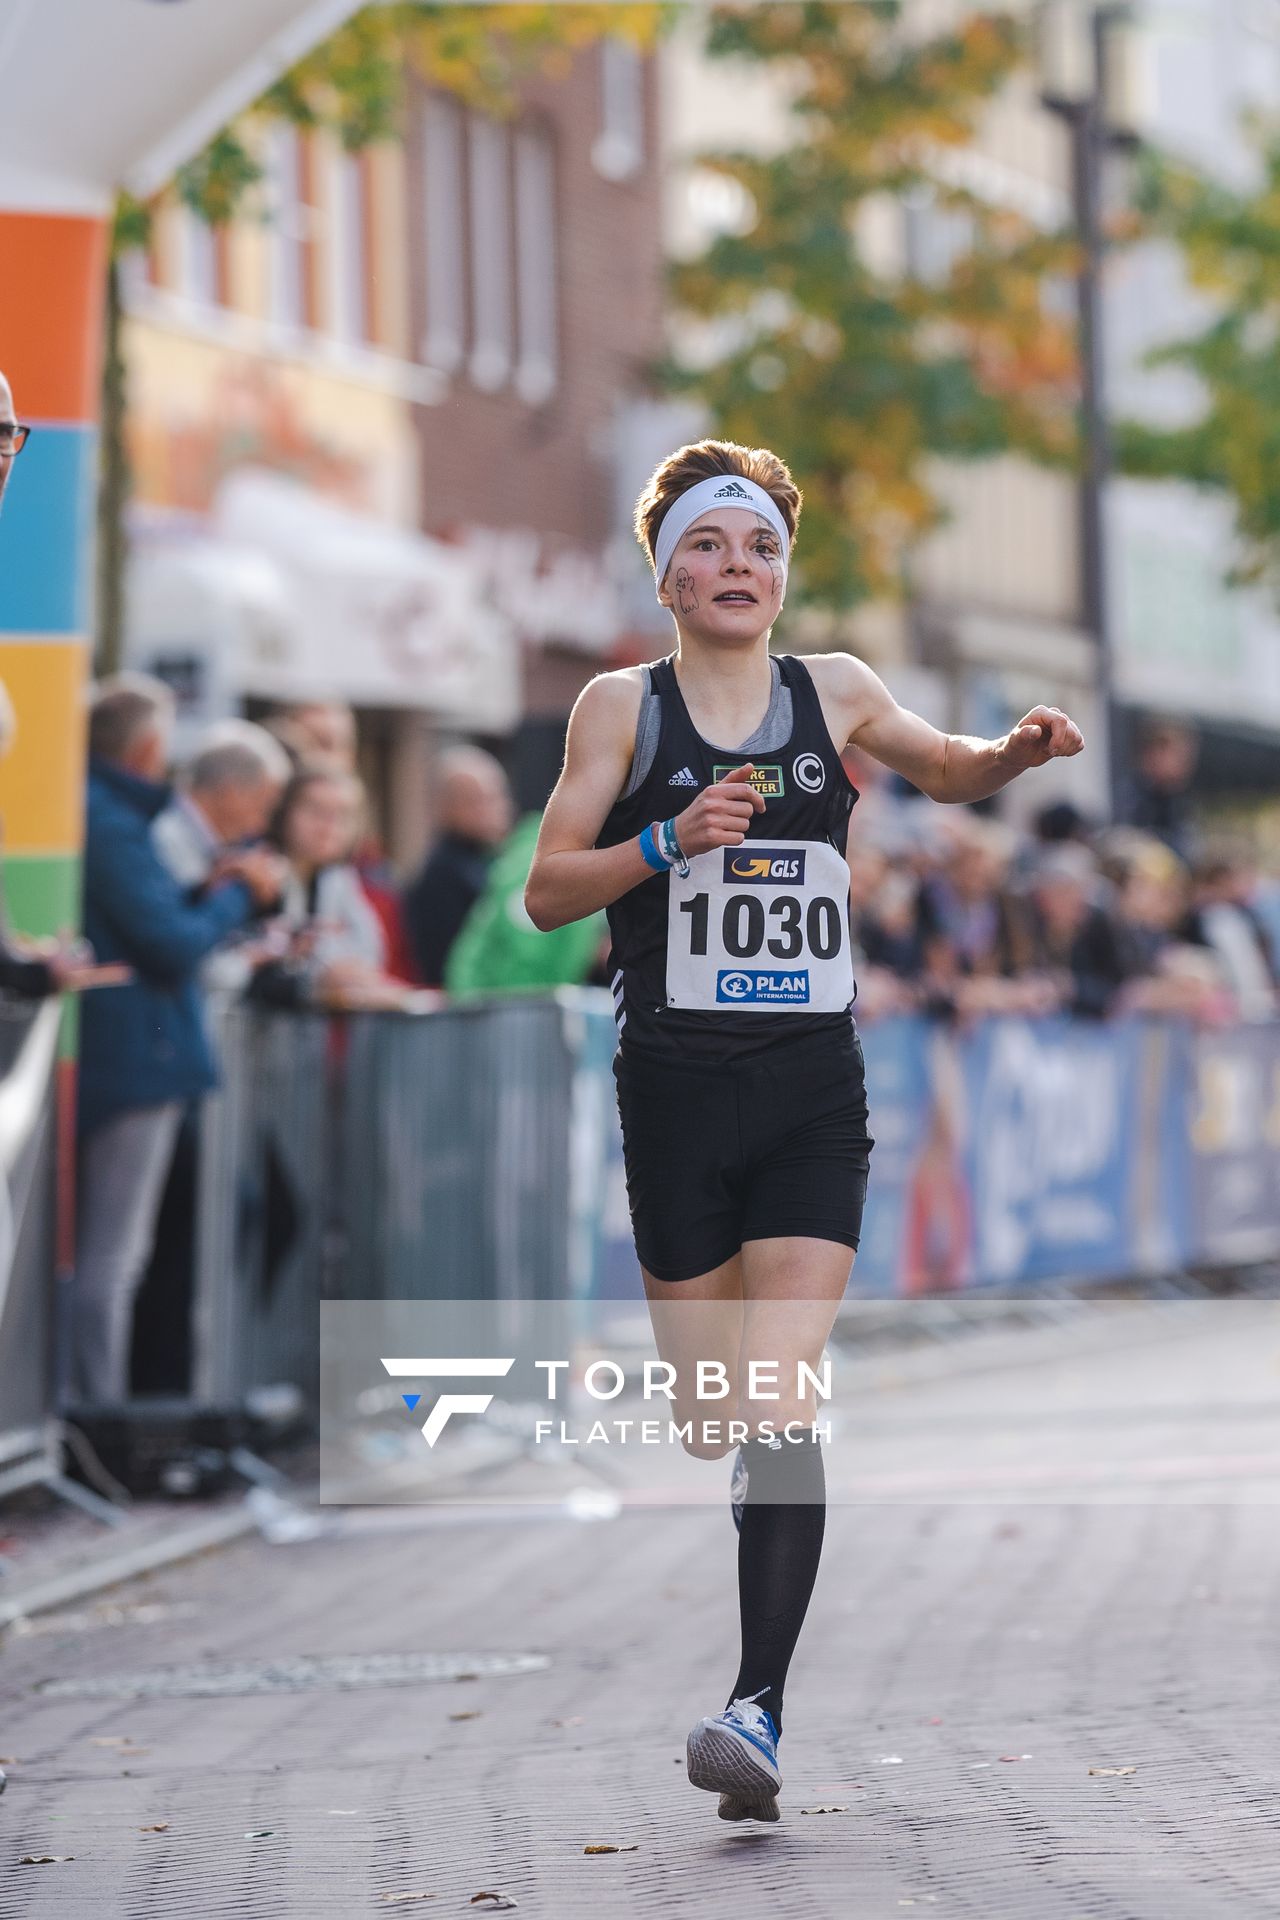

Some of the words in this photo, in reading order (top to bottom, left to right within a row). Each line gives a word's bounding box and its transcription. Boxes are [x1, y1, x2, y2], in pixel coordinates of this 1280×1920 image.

[714, 491, 753, 500] adidas
[668, 778, 699, 787] adidas
[770, 859, 799, 878] GLS
[680, 892, 842, 960] 1030
[756, 976, 806, 992] PLAN
